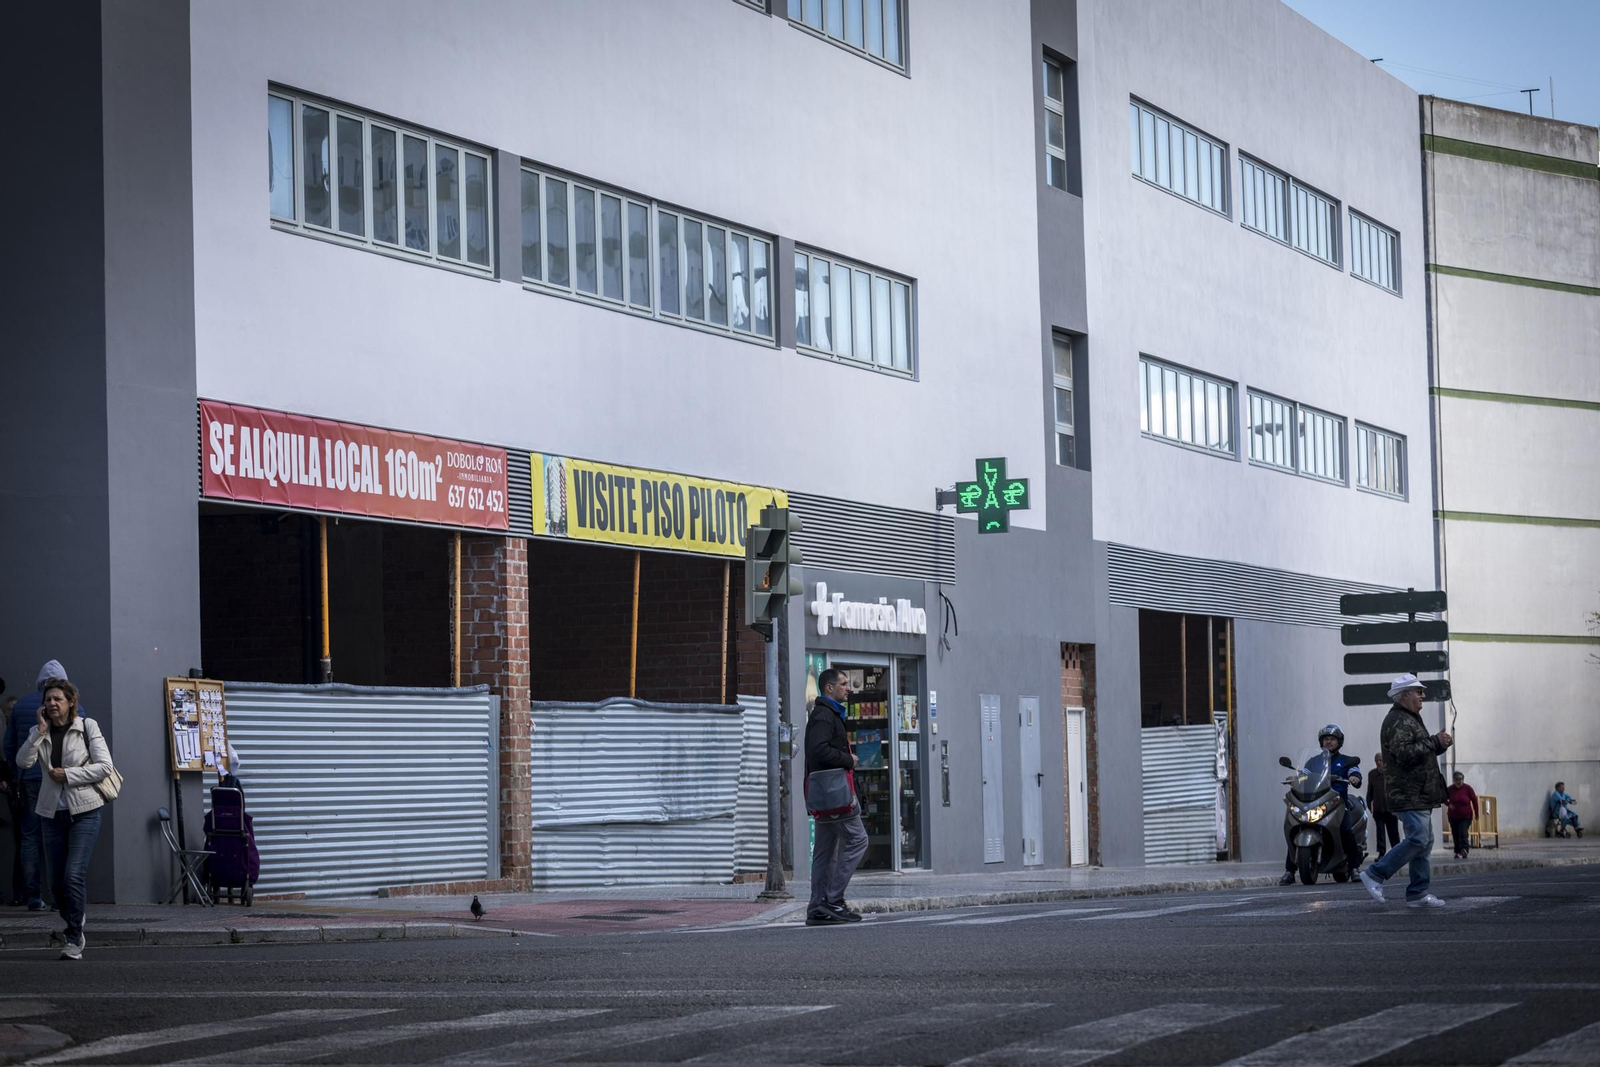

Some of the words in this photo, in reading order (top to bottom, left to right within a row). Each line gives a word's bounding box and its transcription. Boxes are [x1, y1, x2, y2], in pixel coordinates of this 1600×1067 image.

[209, 420, 236, 476] SE
[239, 425, 323, 488] ALQUILA
[325, 438, 383, 495] LOCAL
[485, 456, 503, 475] ROA
[448, 484, 466, 508] 637
[468, 486, 485, 511] 612
[486, 489, 504, 513] 452
[573, 468, 638, 534] VISITE
[641, 478, 685, 540] PISO
[688, 485, 748, 548] PILOTO
